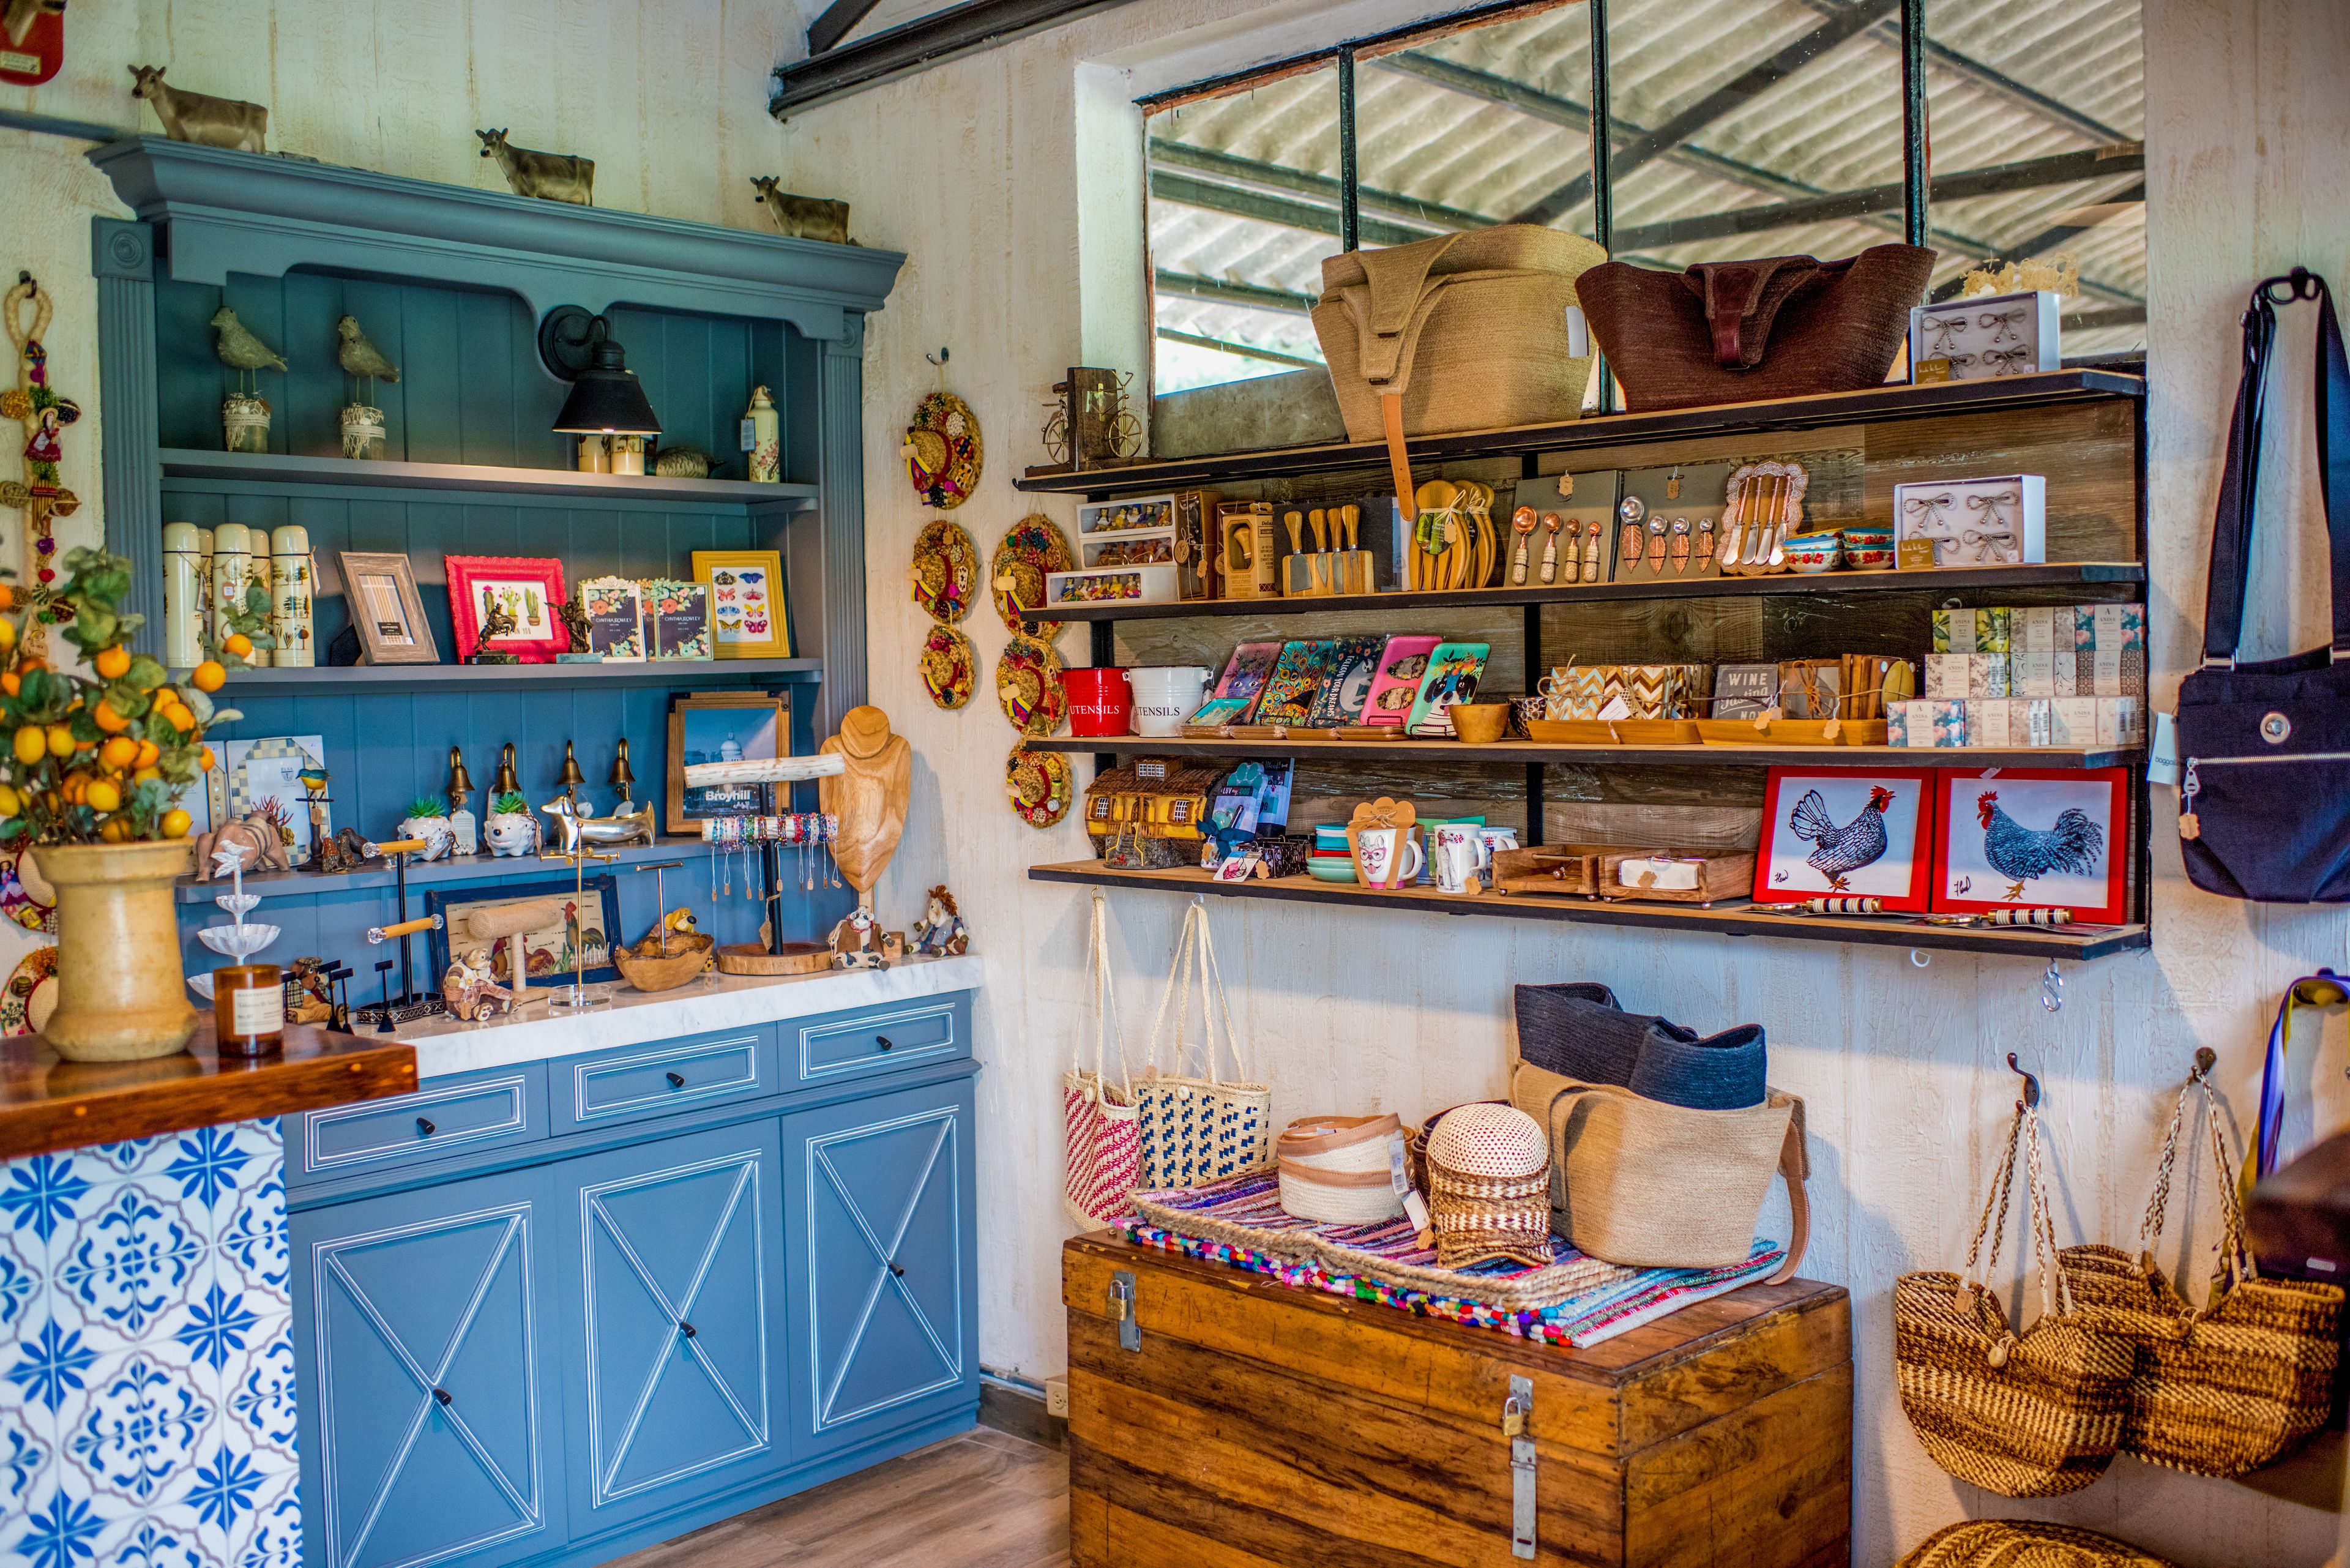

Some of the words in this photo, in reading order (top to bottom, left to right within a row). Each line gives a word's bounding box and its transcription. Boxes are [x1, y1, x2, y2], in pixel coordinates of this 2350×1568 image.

[1336, 655, 1355, 677] FOLLOW
[1728, 673, 1768, 685] WINE
[1331, 678, 1343, 694] YOUR
[1070, 705, 1119, 714] UTENSILS
[1327, 693, 1338, 717] DREAMS
[1740, 711, 1761, 720] NO
[2155, 756, 2176, 766] baggall
[705, 790, 750, 802] Broyhill
